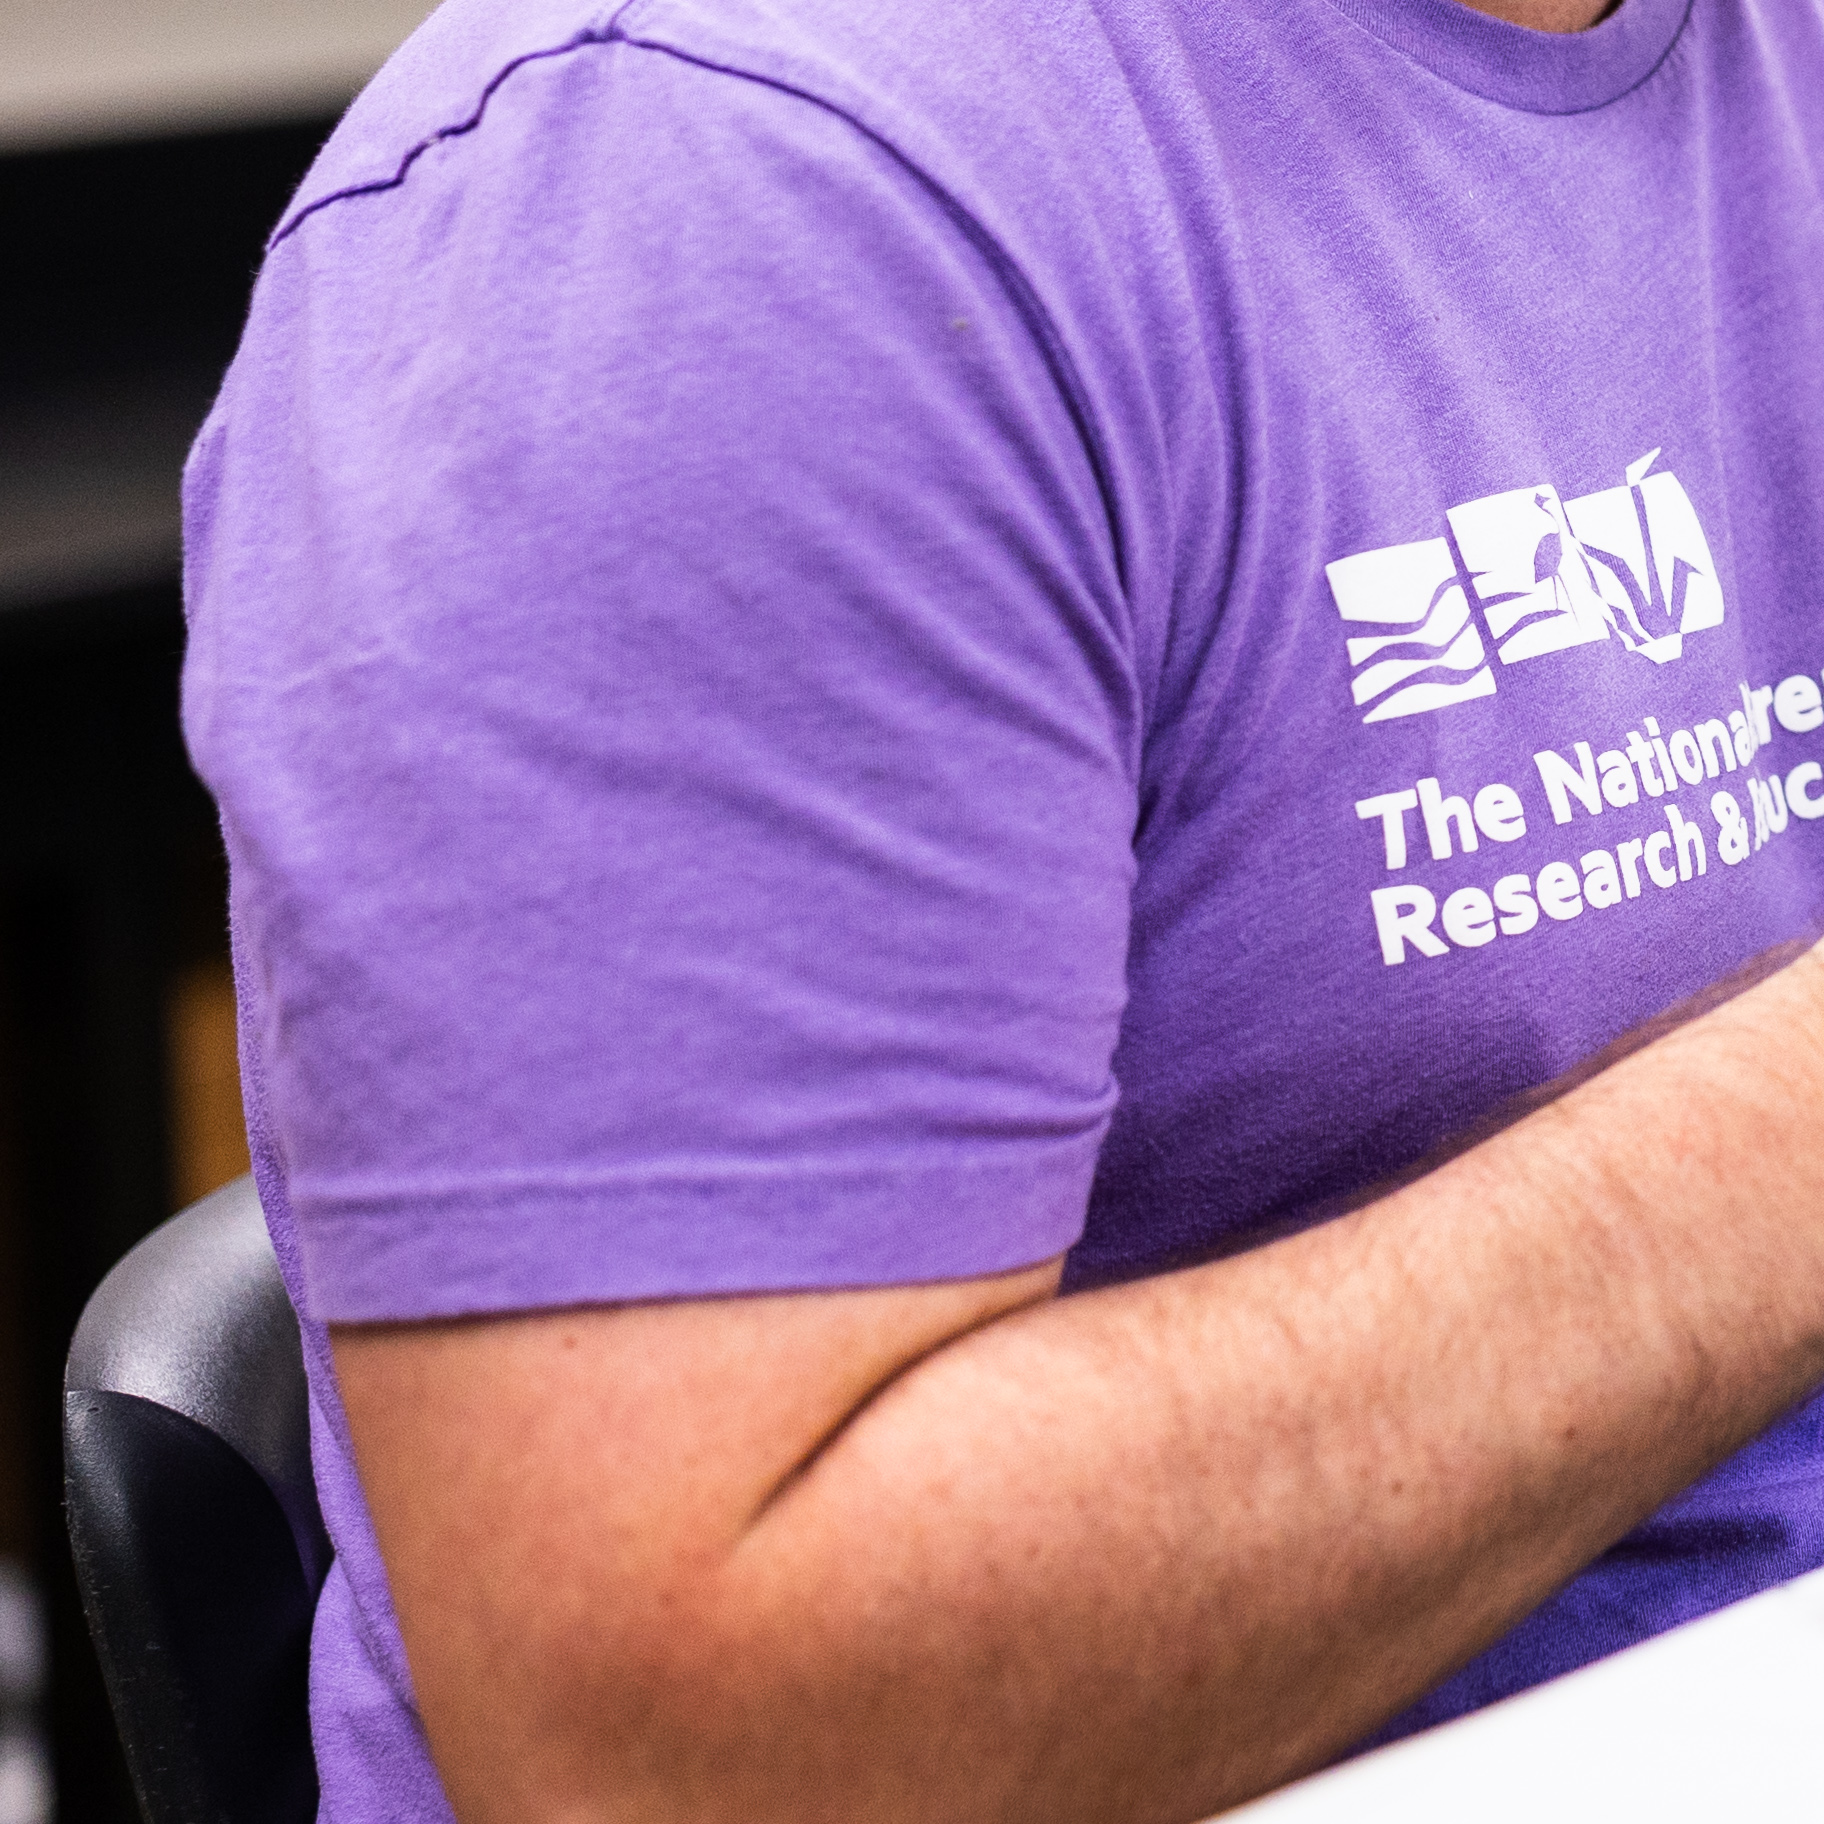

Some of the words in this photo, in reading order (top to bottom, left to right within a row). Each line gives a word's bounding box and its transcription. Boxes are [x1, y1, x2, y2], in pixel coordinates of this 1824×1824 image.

[1355, 777, 1527, 871] The
[1371, 804, 1707, 966] Research
[1711, 791, 1751, 866] &
